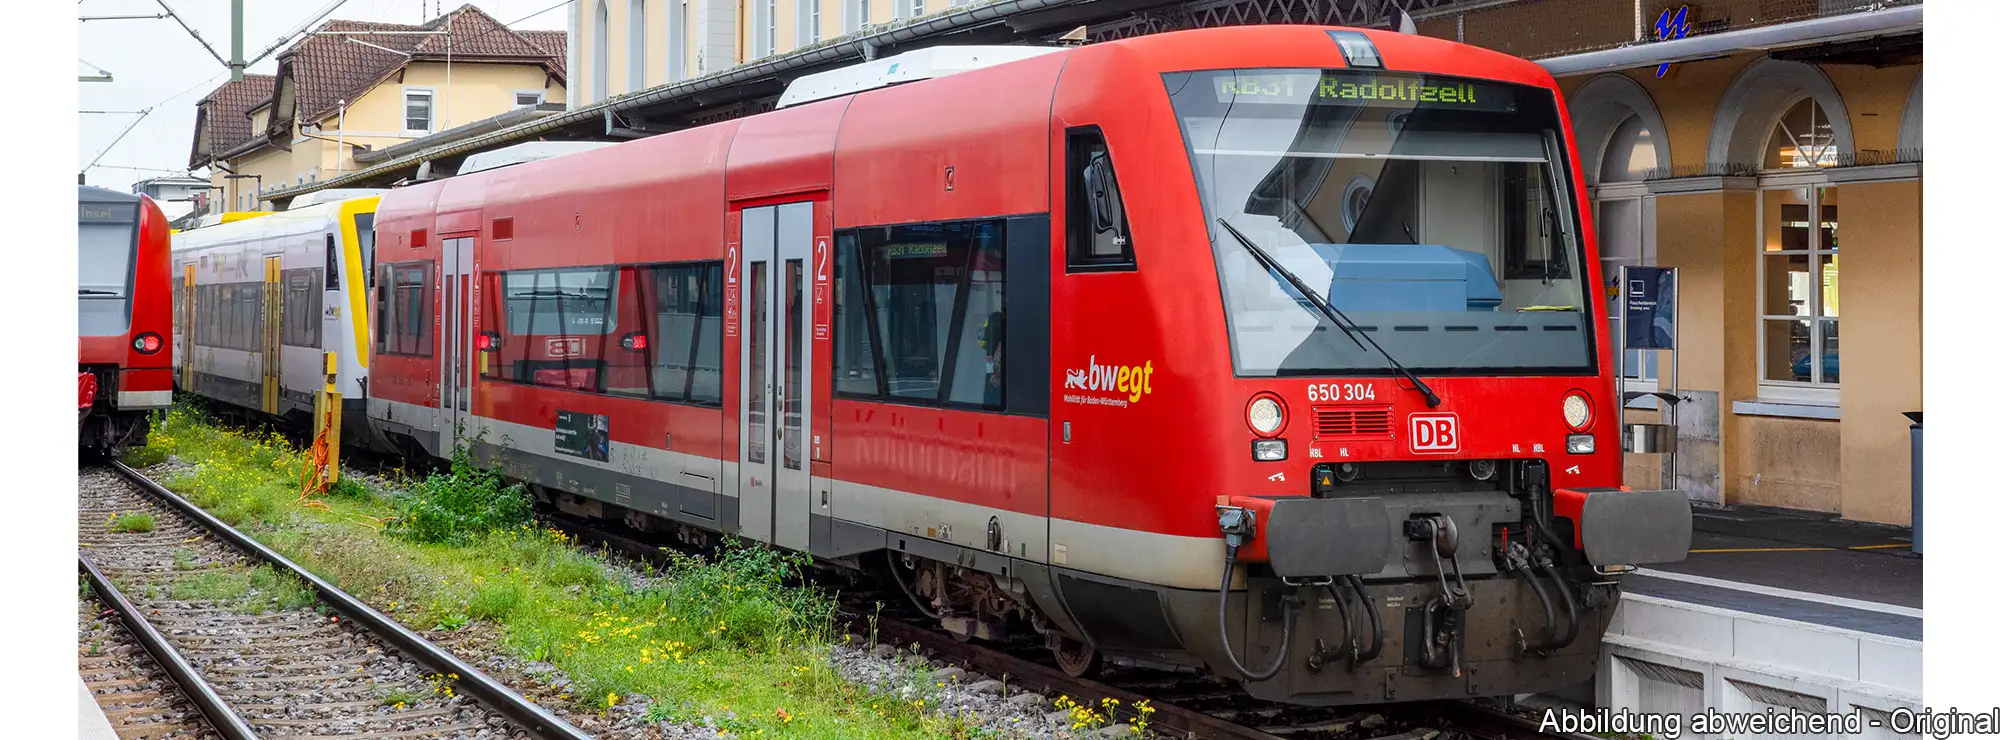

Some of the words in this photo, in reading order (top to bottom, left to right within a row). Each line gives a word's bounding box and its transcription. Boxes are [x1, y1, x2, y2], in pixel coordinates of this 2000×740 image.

[1319, 77, 1476, 104] Radolfzell
[728, 246, 736, 283] 2
[817, 239, 827, 281] 2
[1089, 354, 1153, 403] bwegt
[1308, 383, 1340, 402] 650
[1344, 383, 1376, 401] 304
[1415, 420, 1454, 448] DB
[1309, 447, 1323, 459] HBL
[1340, 447, 1350, 458] HL
[1512, 443, 1521, 453] HL
[1533, 443, 1546, 453] HBL
